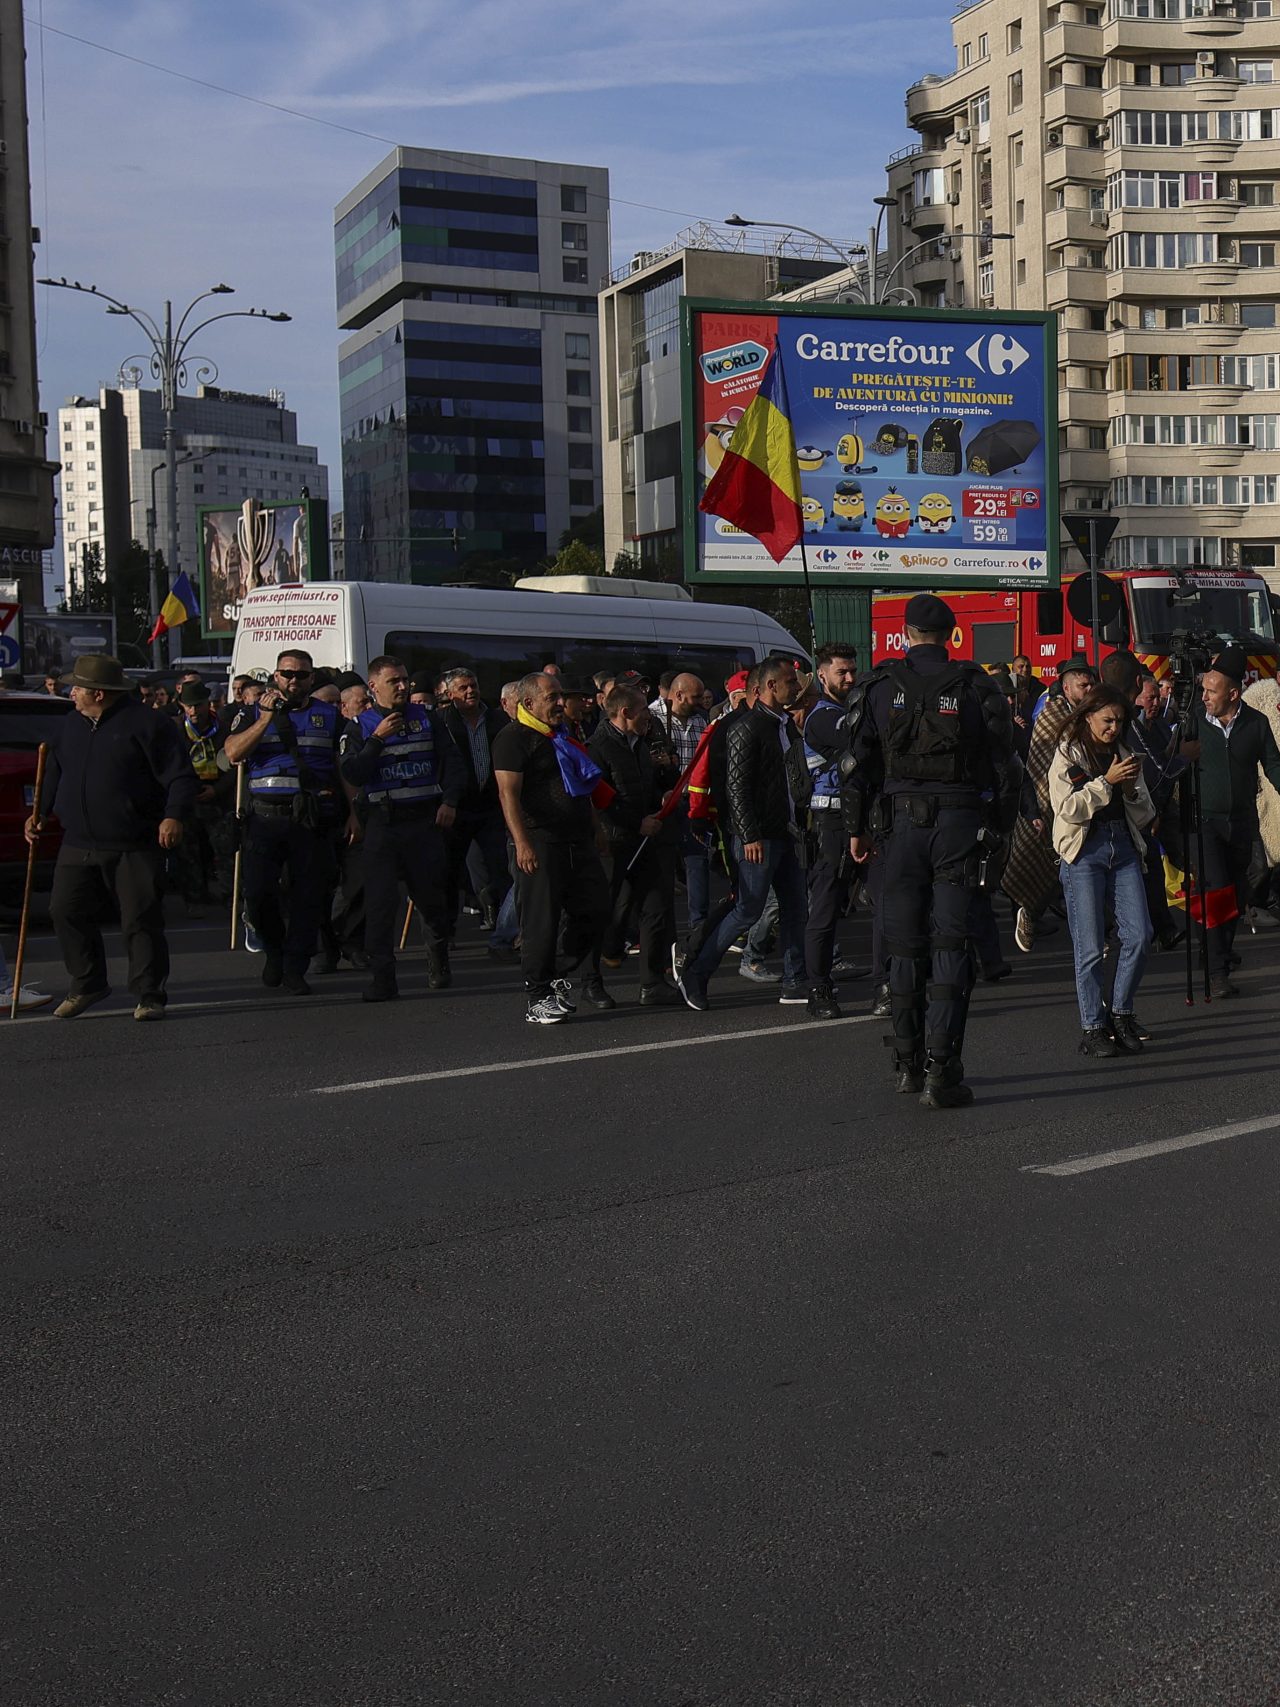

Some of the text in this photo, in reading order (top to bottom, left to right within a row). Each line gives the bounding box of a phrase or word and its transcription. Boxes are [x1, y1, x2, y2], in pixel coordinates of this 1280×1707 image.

[704, 322, 760, 337] PARIS
[796, 333, 954, 365] Carrefour
[707, 352, 760, 375] WORLD
[813, 386, 834, 398] DE
[836, 388, 918, 401] AVENTURĂ
[920, 391, 941, 402] CU
[835, 401, 888, 412] Descoperă
[890, 403, 928, 416] colecția
[942, 406, 993, 416] magazine.
[974, 499, 996, 516] 29
[974, 525, 996, 541] 59
[954, 557, 1019, 568] Carrefour.ro
[248, 591, 338, 604] www.septimiusrl.ro
[243, 614, 336, 628] TRANSPORT PERSOANE
[252, 630, 322, 642] ITP SI TAHOGRAF
[1040, 644, 1056, 656] DMV
[1046, 667, 1056, 676] 112
